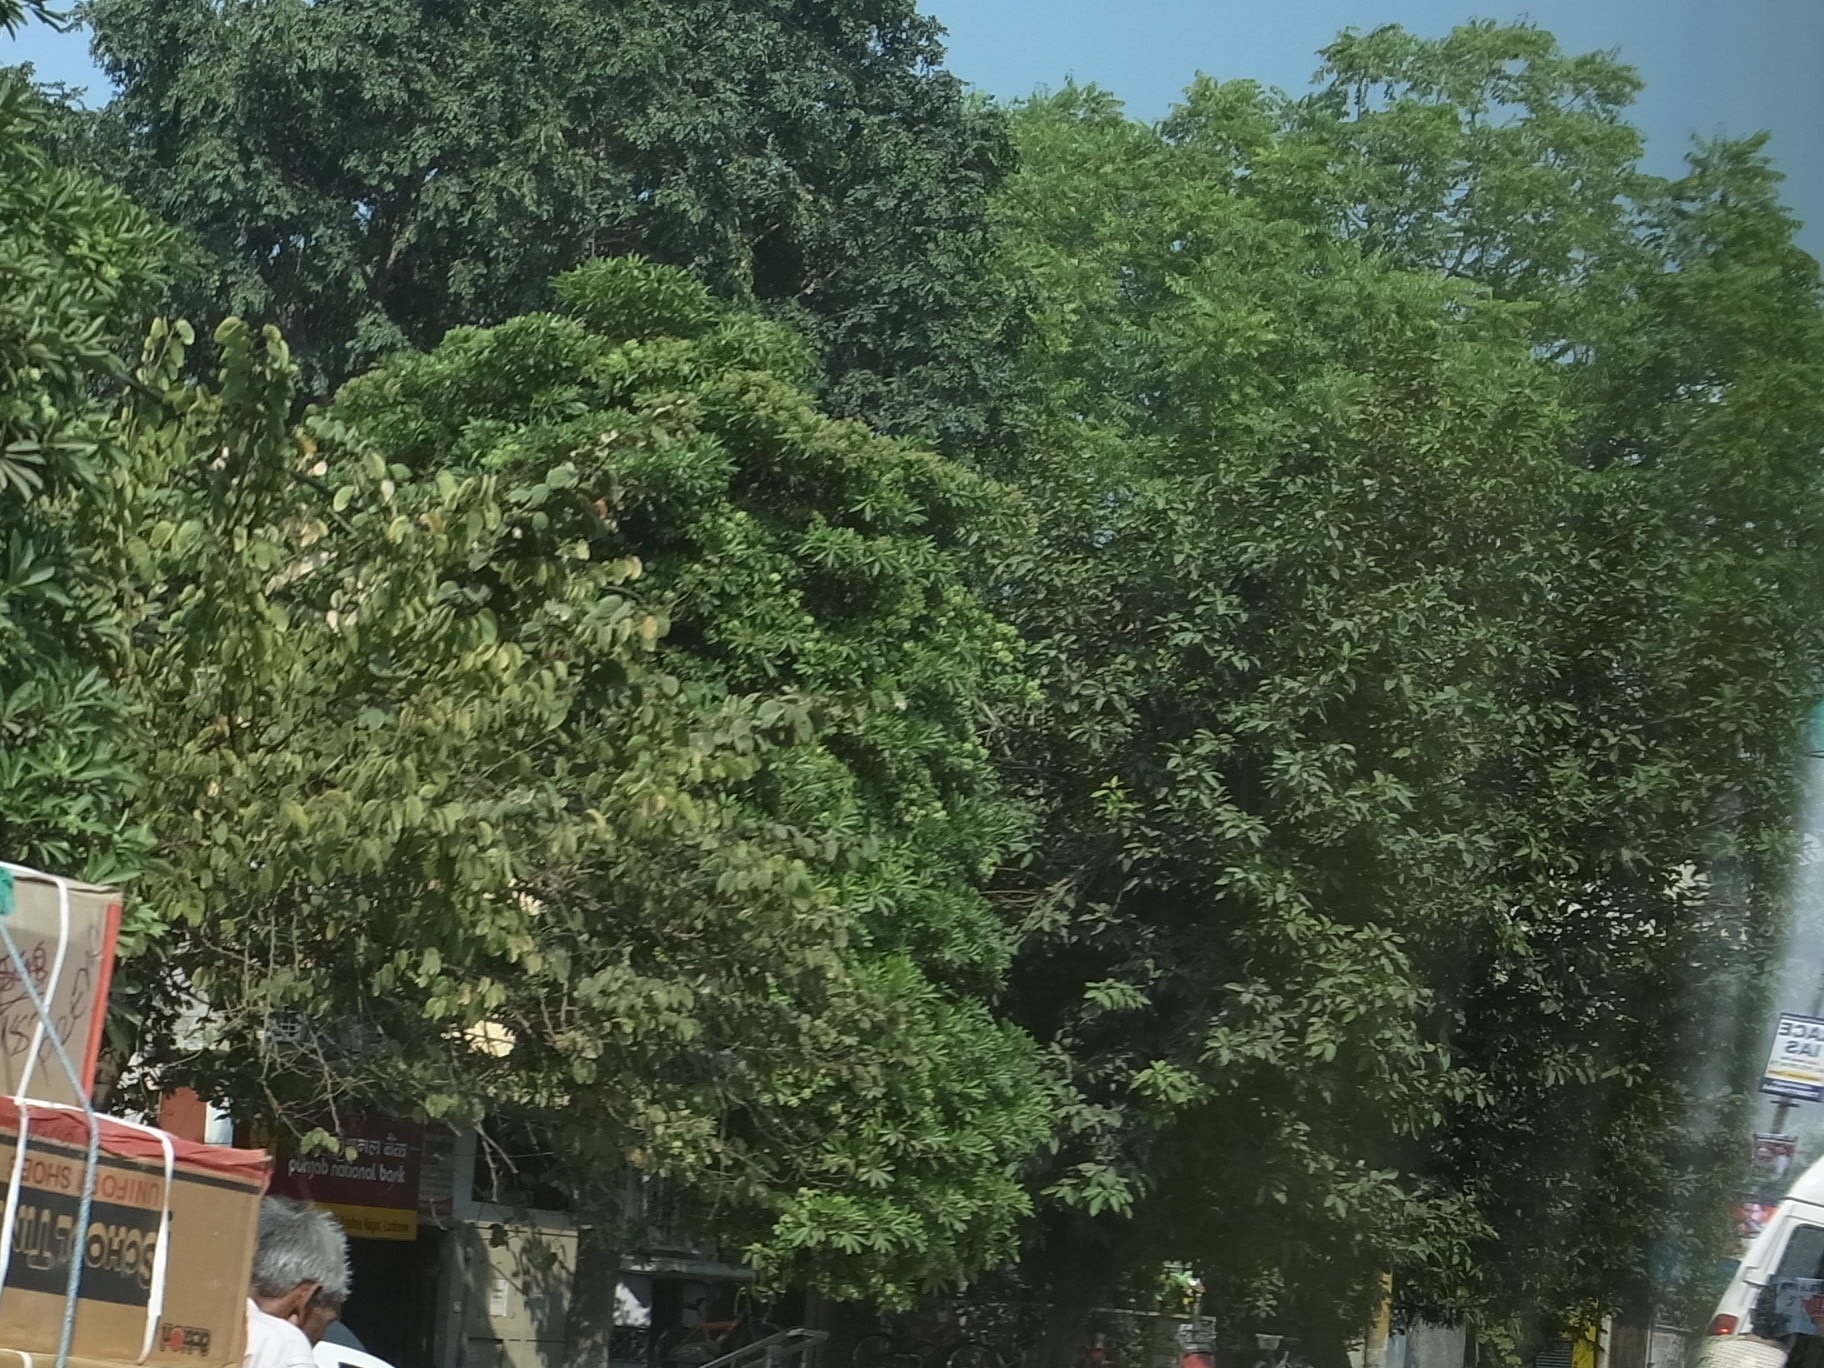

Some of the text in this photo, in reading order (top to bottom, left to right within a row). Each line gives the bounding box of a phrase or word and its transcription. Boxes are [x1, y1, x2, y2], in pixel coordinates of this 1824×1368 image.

[288, 1157, 407, 1184] punjab national bank
